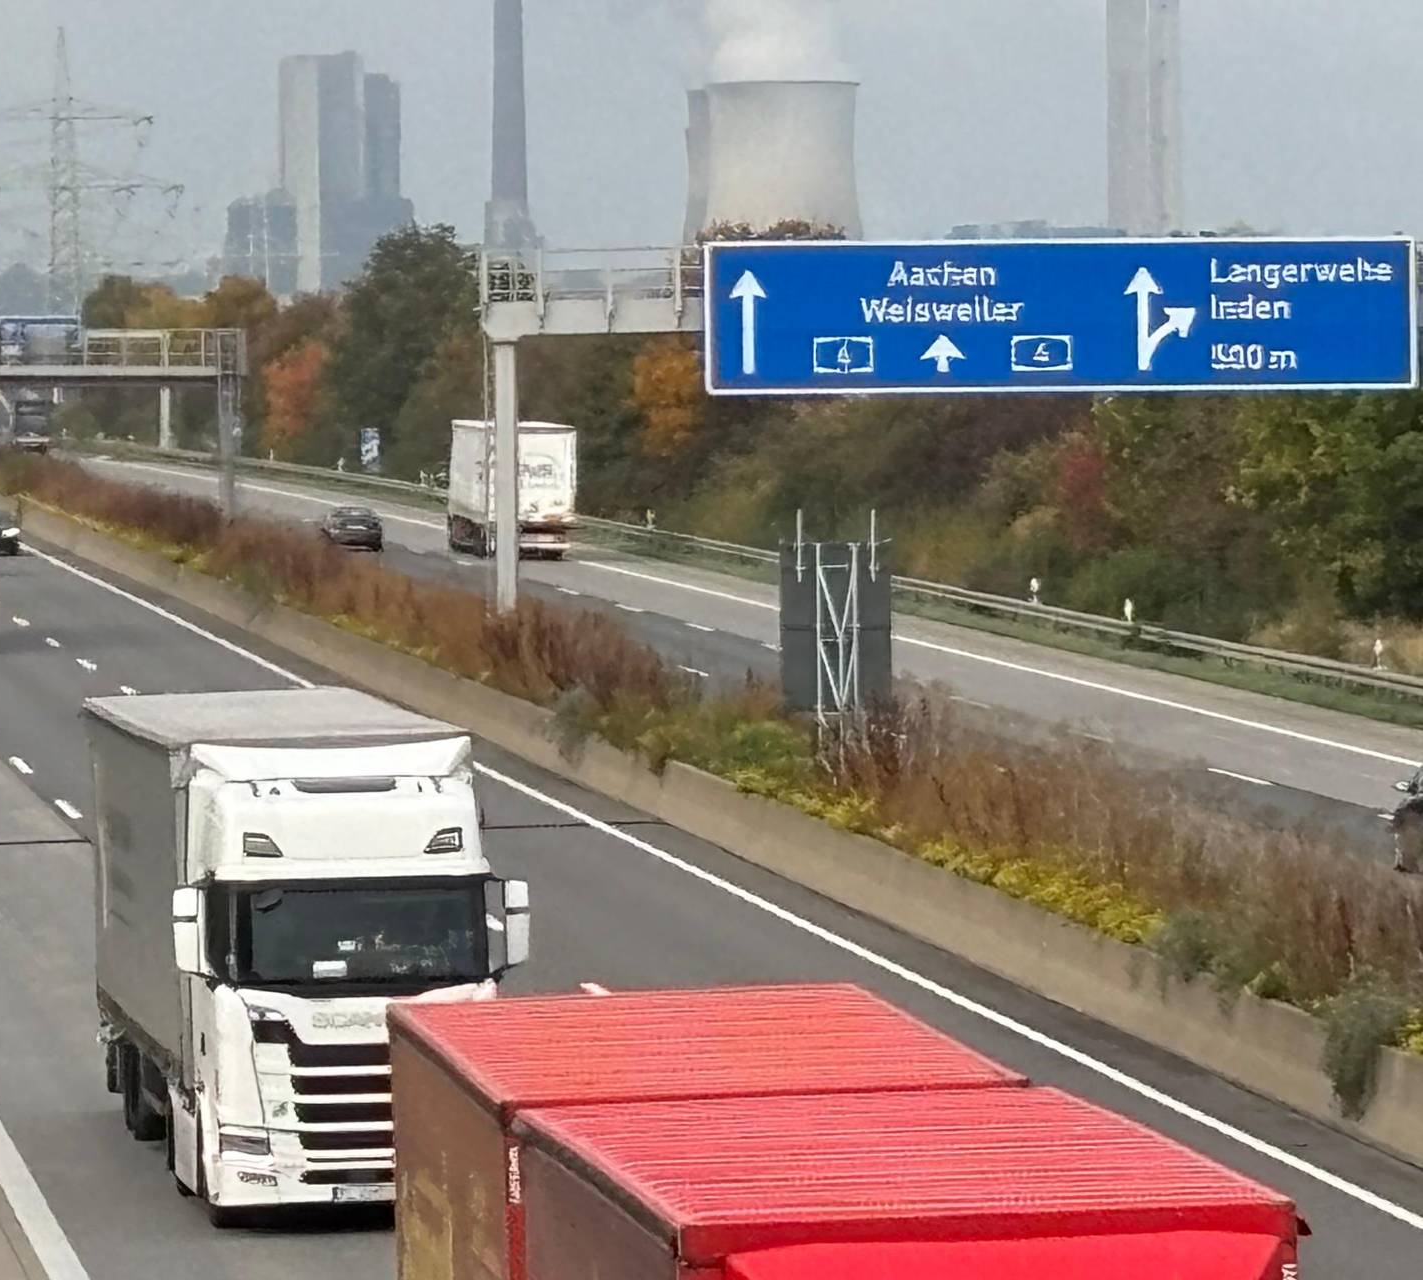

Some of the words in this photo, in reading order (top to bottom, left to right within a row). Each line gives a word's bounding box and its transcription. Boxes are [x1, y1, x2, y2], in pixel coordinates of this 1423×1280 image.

[887, 260, 997, 287] Aachen
[860, 294, 1025, 323] Weisweiler
[1210, 293, 1292, 320] Inden
[1268, 349, 1298, 371] m
